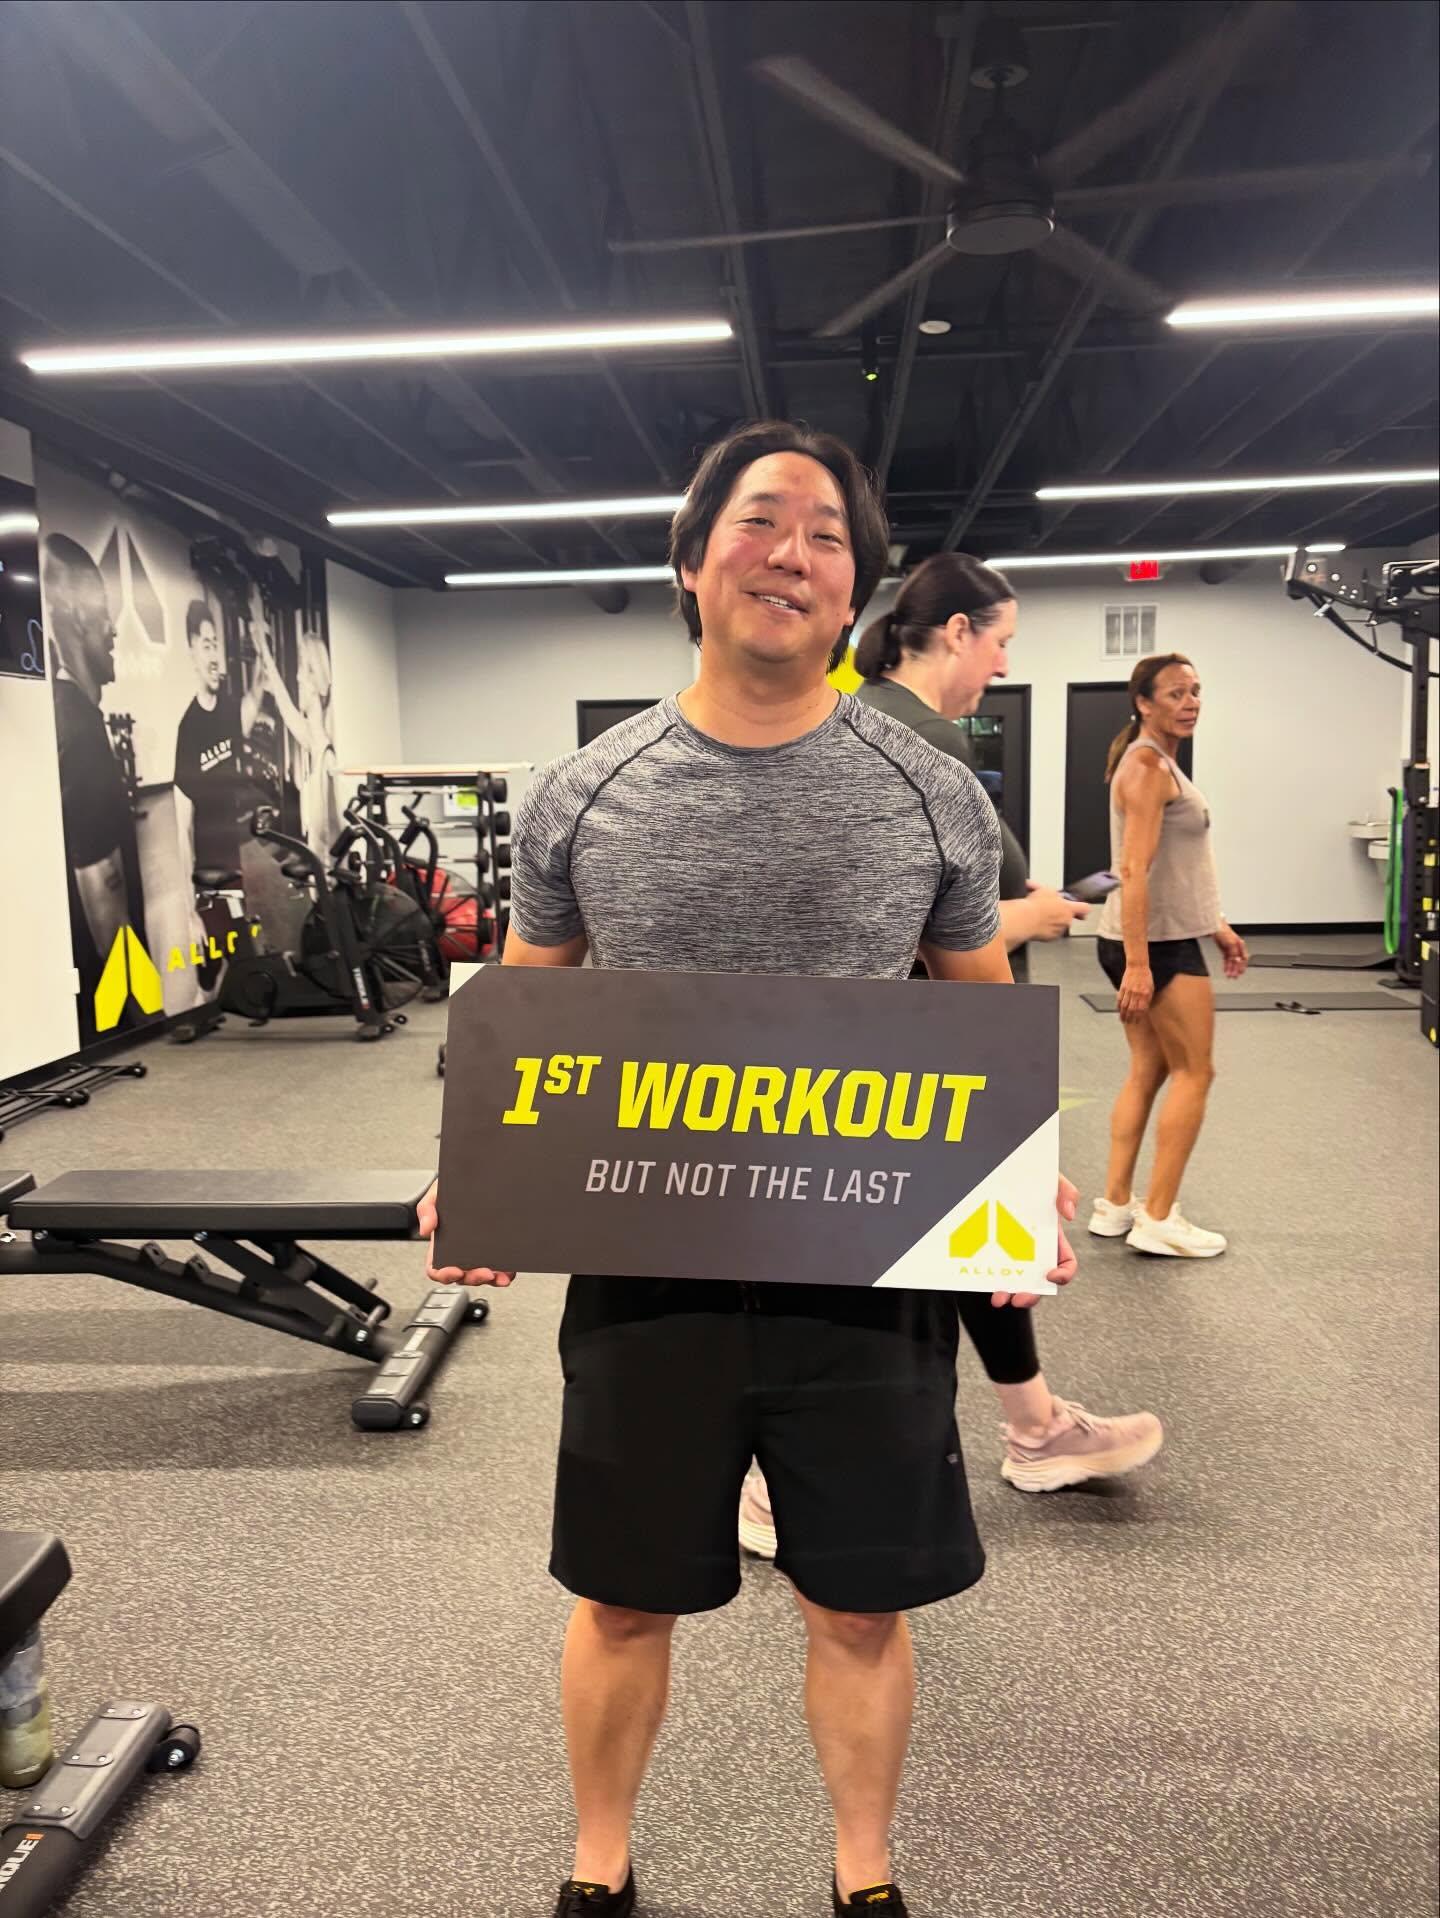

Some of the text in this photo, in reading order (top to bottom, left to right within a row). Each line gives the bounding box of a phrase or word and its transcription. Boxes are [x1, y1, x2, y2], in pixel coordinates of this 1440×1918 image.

[502, 1054, 987, 1142] 1ST WORKOUT
[585, 1159, 911, 1205] BUT NOT THE LAST
[959, 1265, 1025, 1277] ALLOY
